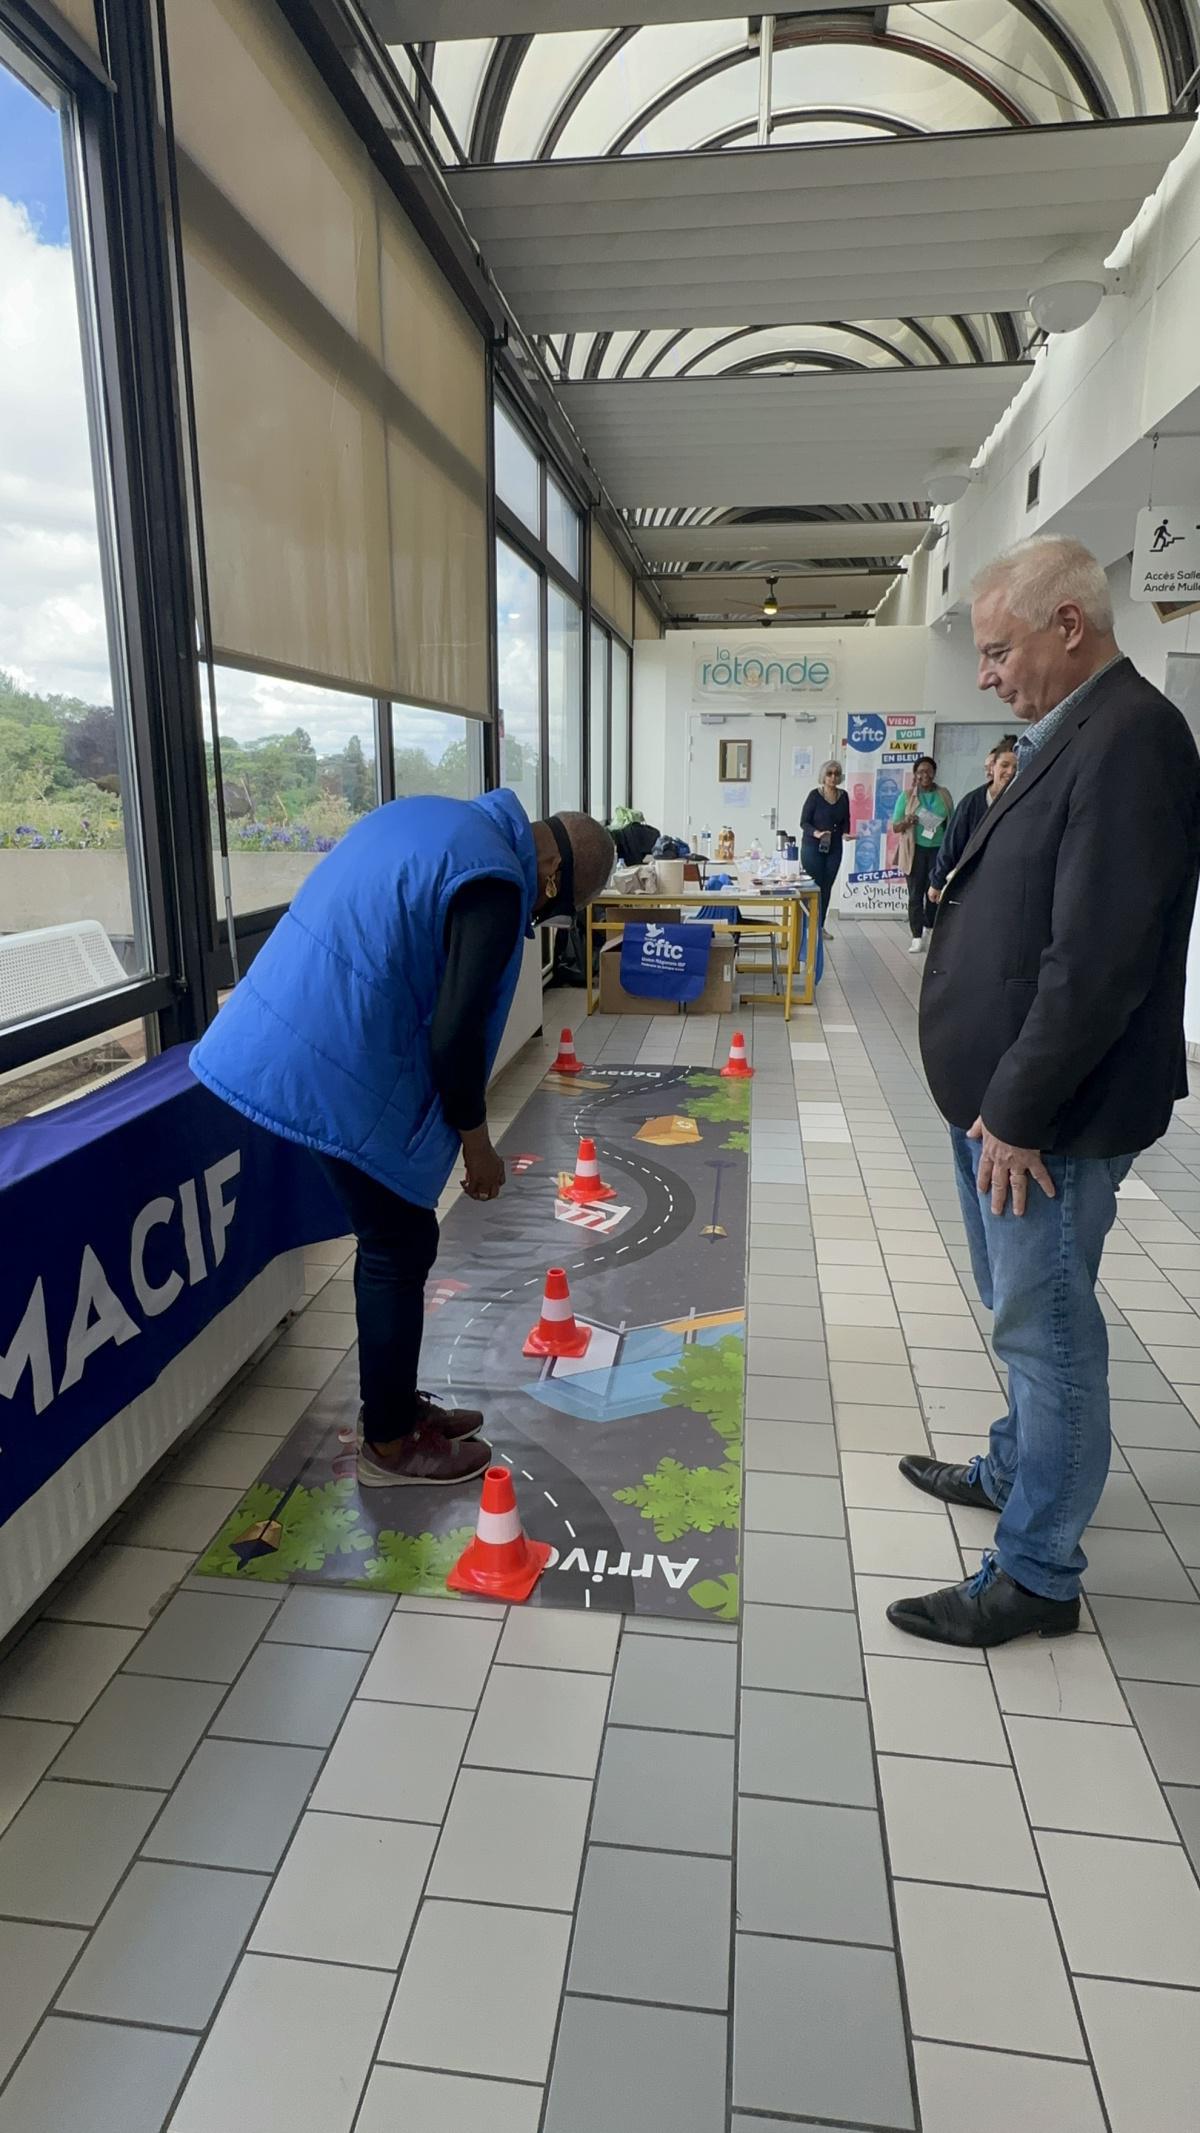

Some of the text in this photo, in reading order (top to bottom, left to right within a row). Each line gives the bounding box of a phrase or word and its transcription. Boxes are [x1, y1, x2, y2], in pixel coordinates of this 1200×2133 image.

[1144, 570, 1175, 581] Accès
[1143, 582, 1175, 592] André
[716, 646, 730, 661] la
[702, 656, 830, 685] rotonde
[888, 717, 914, 725] VIENS
[852, 727, 884, 742] cftc
[900, 730, 922, 738] VOIR
[890, 742, 917, 751] LA VIE
[883, 755, 895, 763] EN
[896, 753, 918, 762] BLEU
[857, 870, 904, 881] CFTC AP-H
[842, 881, 909, 900] Se syndiqu
[855, 896, 909, 911] autremen
[643, 939, 683, 960] cftc
[544, 1546, 699, 1589] Arriv
